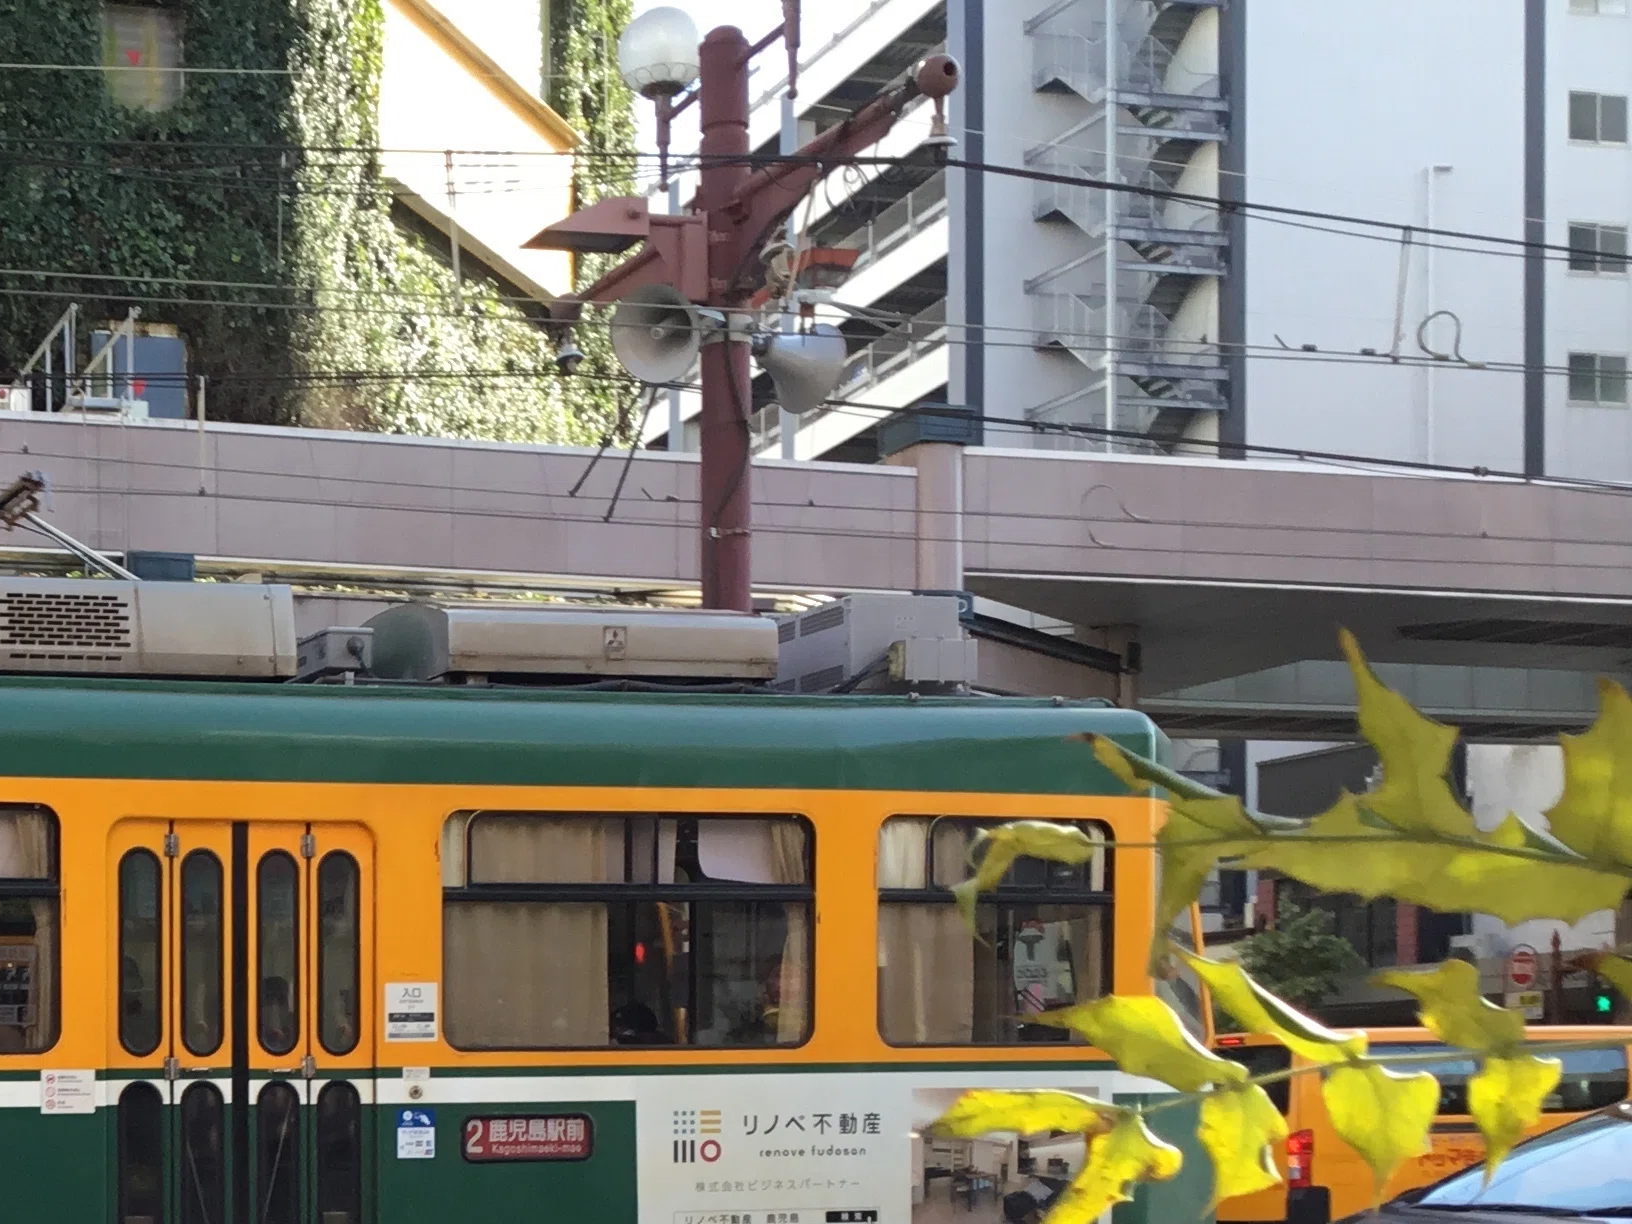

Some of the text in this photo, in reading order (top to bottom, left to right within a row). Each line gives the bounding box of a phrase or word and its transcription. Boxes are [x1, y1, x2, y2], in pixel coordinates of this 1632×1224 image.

[401, 987, 422, 998] 入口
[743, 1112, 881, 1136] リノベ不動産
[466, 1119, 484, 1154] 2
[489, 1118, 585, 1142] 鹿児島駅前
[759, 1148, 806, 1157] renove
[695, 1178, 861, 1193] 株式会社ビジネスパートナー
[766, 1212, 800, 1224] 鹿児島
